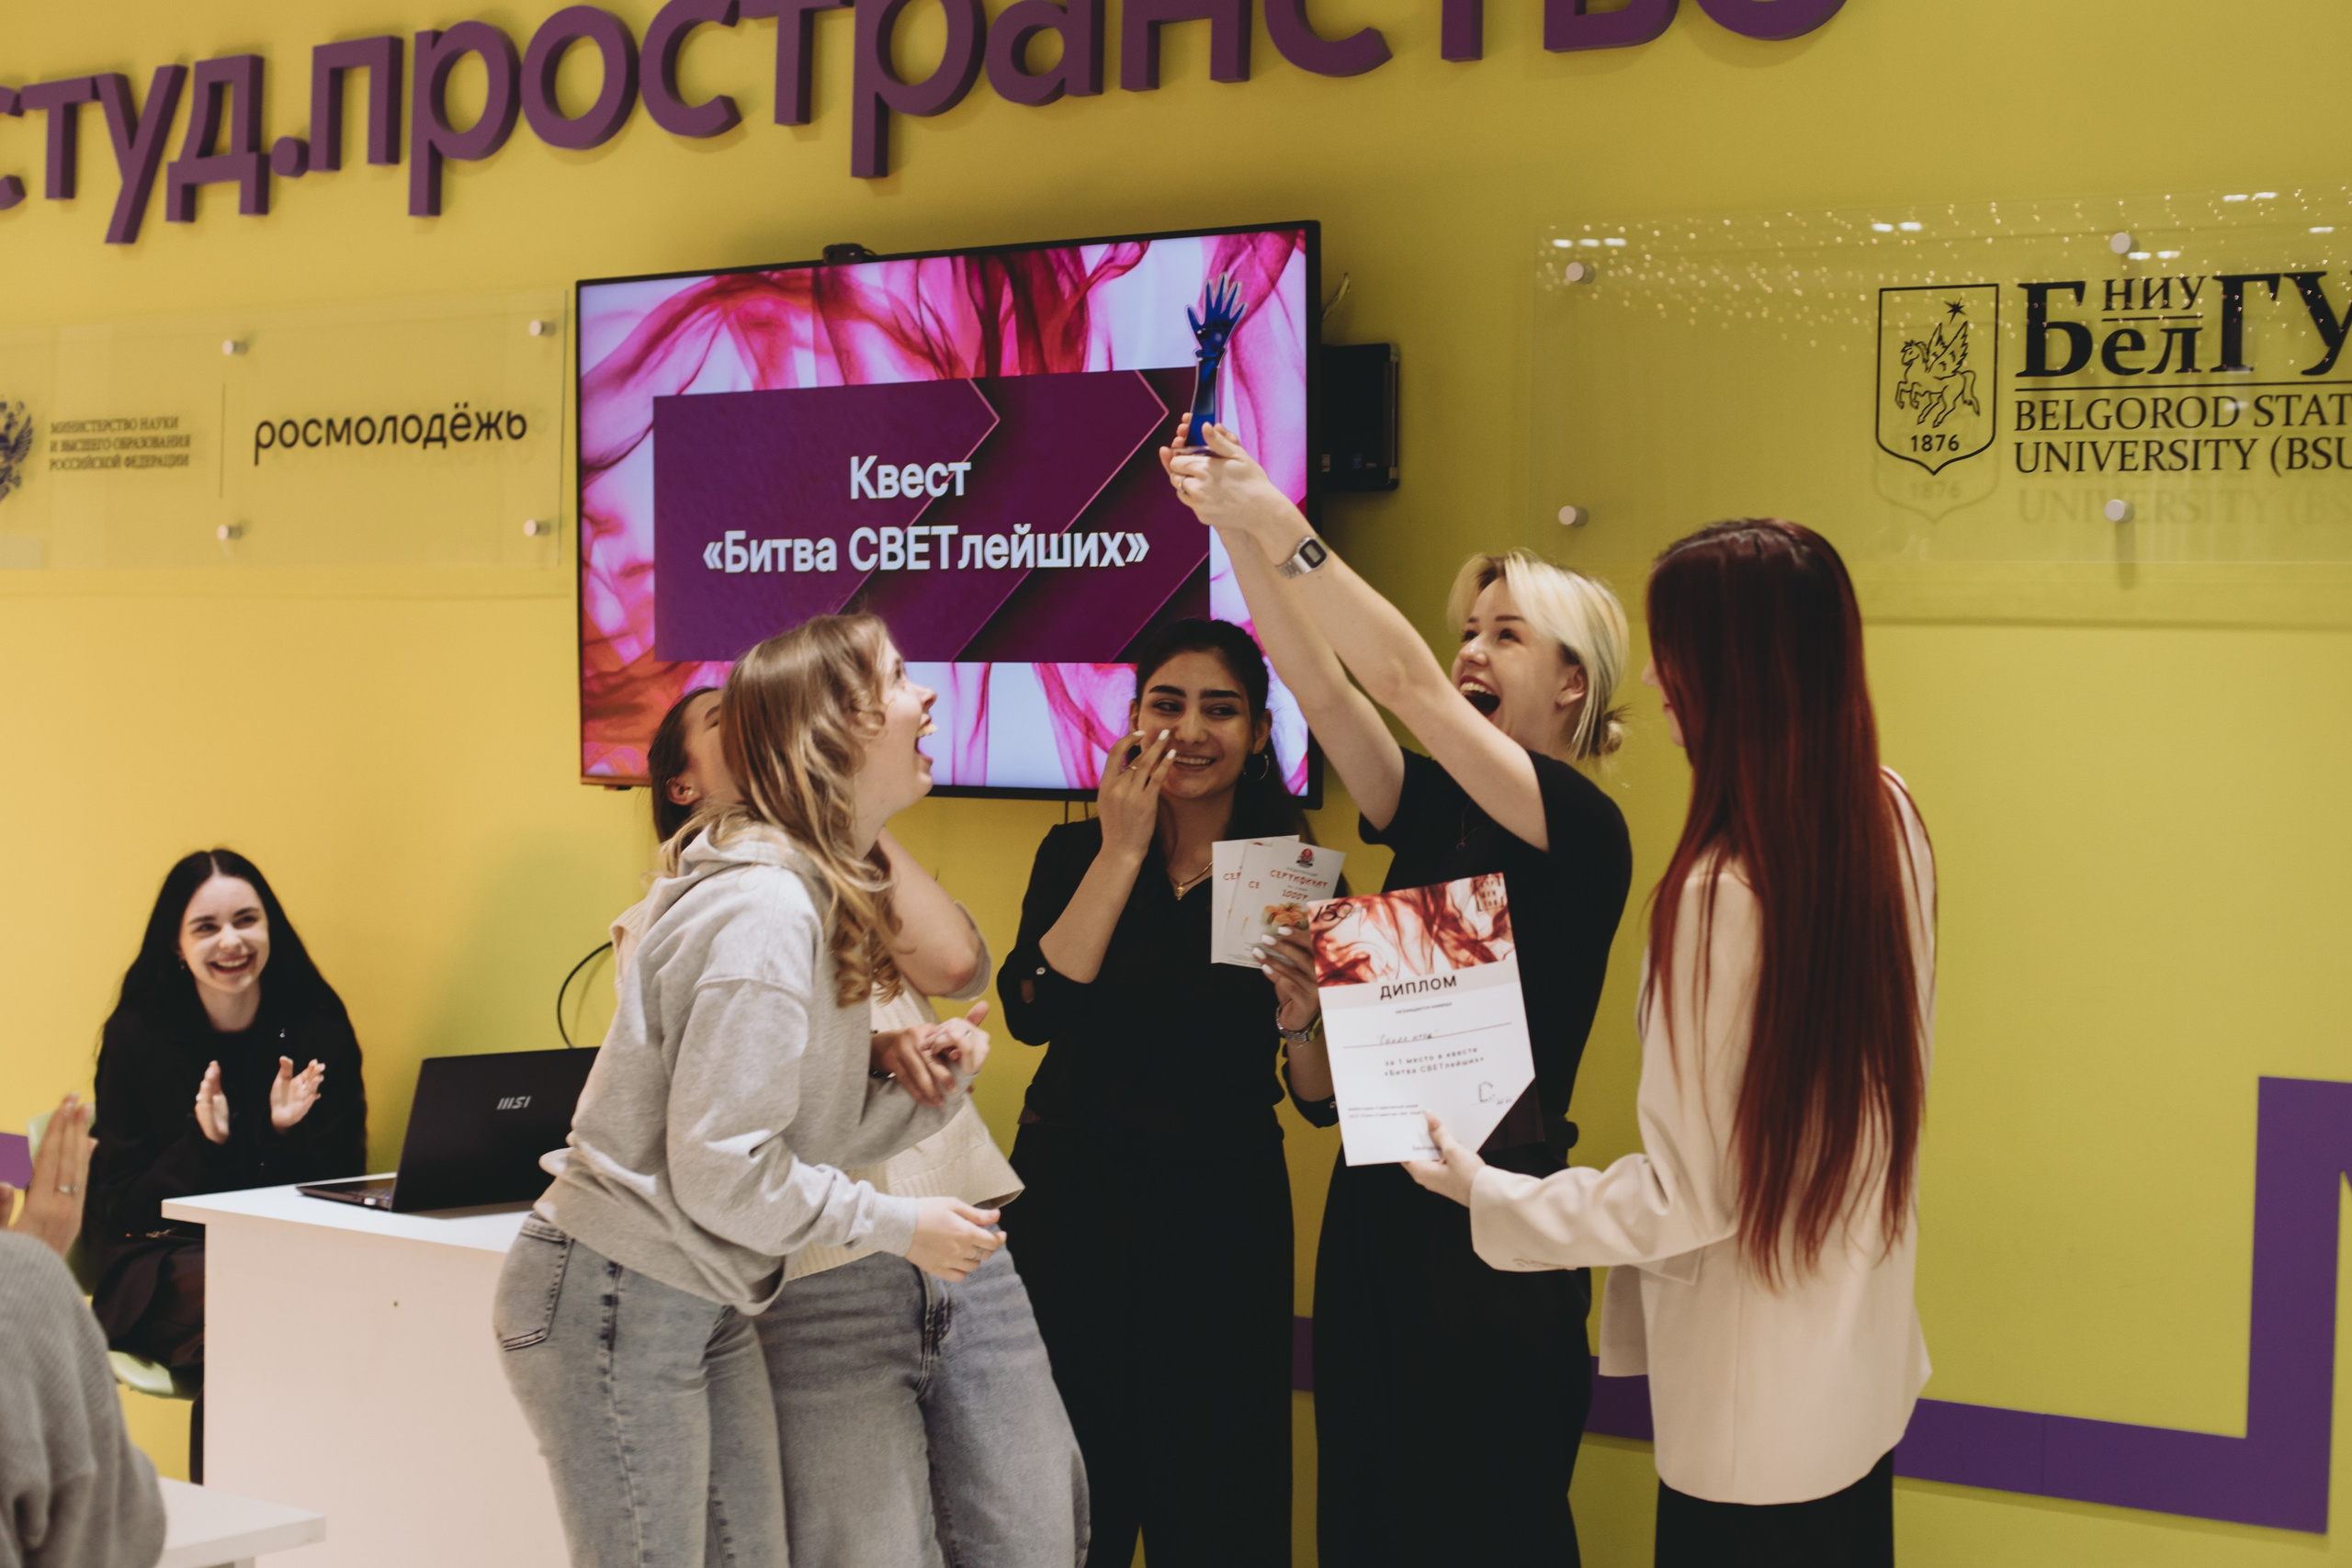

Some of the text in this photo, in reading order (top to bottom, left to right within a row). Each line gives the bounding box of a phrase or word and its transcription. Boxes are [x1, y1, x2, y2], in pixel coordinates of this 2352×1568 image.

[2102, 276, 2207, 311] НИУ
[51, 416, 179, 434] МИНИСТЕРСТВО НАУКИ
[2014, 395, 2241, 432] BELGOROD
[50, 434, 191, 453] И ВЫСШЕГО ОБРАЗОВАНИЯ
[254, 401, 527, 467] росмолодёжь
[1910, 434, 1960, 452] 1876
[49, 453, 189, 471] РОССИЙСКОЙ ФЕДЕРАЦИИ
[2014, 438, 2259, 474] UNIVERSITY
[850, 455, 971, 500] Квест
[702, 524, 1151, 573] «Битва СВЕТлейших»
[1380, 975, 1457, 1000] ДИПЛОМ
[1406, 1055, 1434, 1064] место
[1446, 1047, 1478, 1058] квесте
[496, 1096, 531, 1110] MSI
